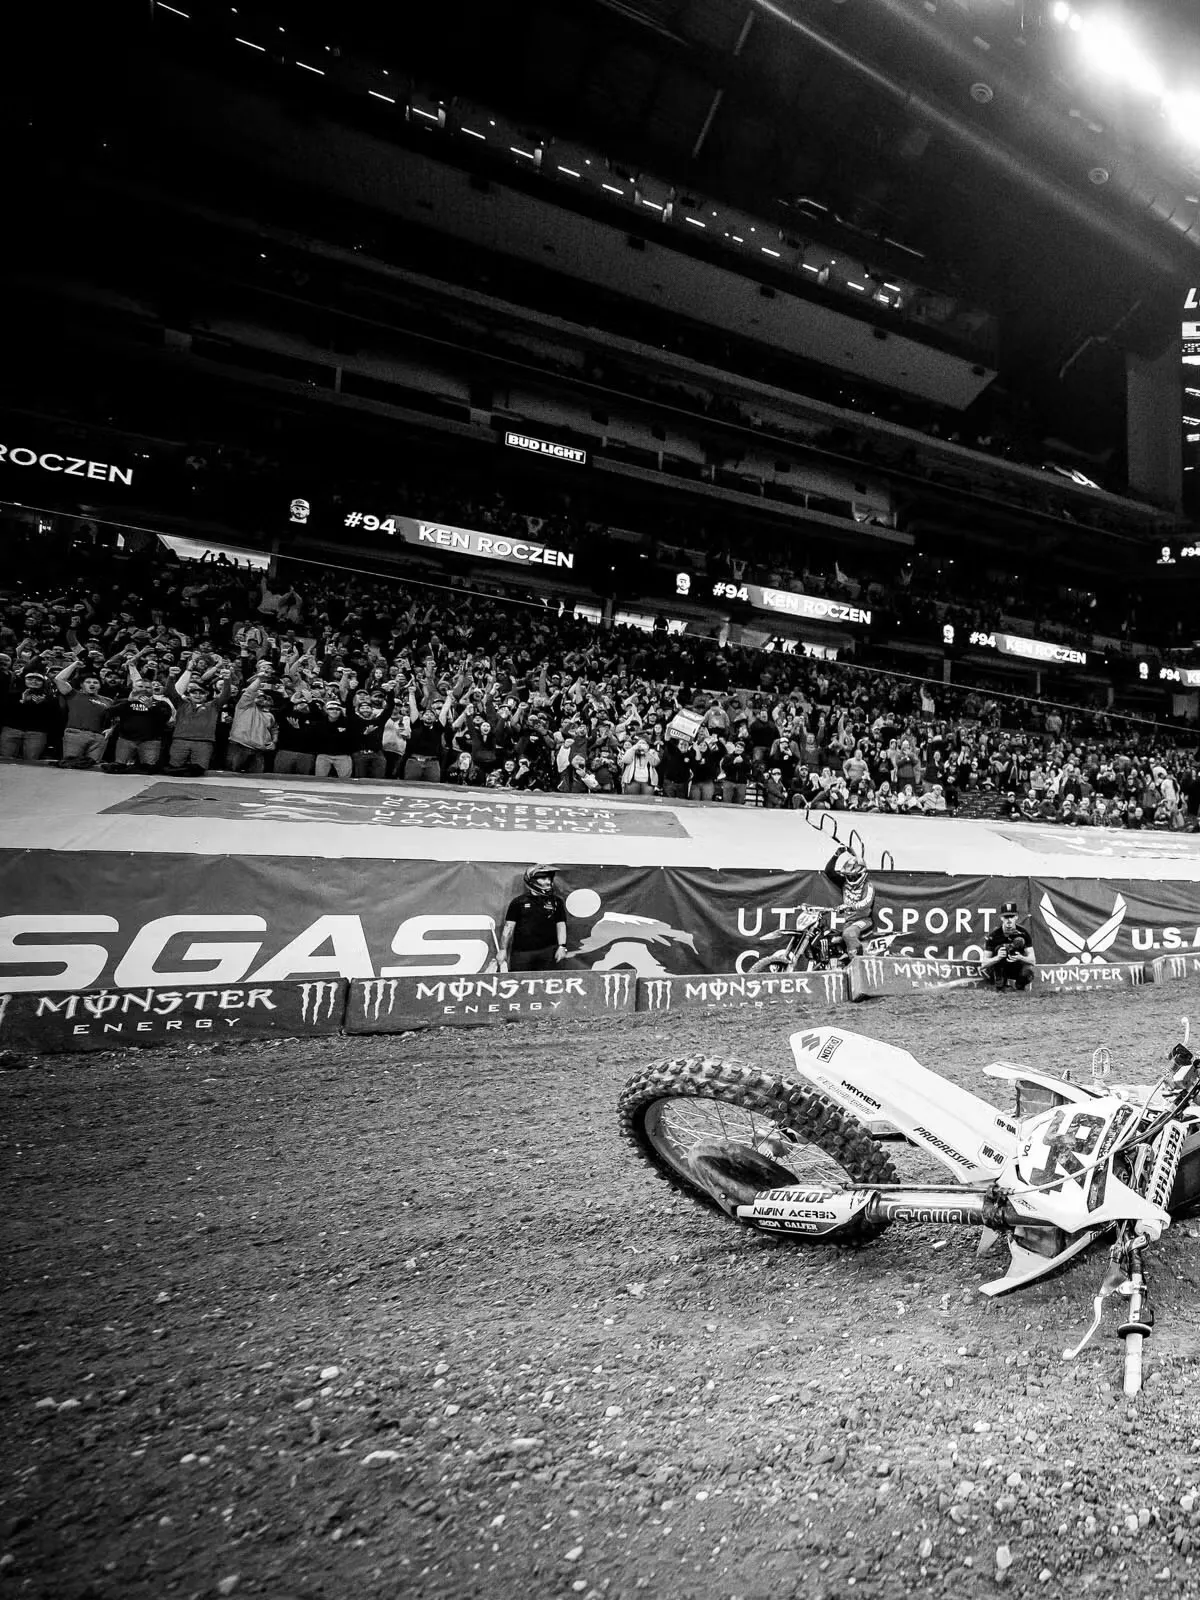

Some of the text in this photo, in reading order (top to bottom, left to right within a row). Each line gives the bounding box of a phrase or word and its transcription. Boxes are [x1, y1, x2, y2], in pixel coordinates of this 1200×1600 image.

[508, 434, 583, 461] BUD LIGHT
[0, 443, 133, 486] ROCZEN
[344, 511, 574, 569] #94 KEN ROCZEN
[1181, 547, 1200, 557] #94
[713, 582, 872, 625] #94 KEN ROCZEN
[969, 631, 1087, 665] #94 KEN ROCZEN
[1160, 667, 1180, 682] #94
[373, 816, 618, 833] COMMISSION
[375, 809, 472, 821] UTAH
[737, 907, 997, 937] UTH SPORT
[1131, 926, 1189, 950] U.S.
[0, 914, 497, 991] SGAS
[1040, 966, 1124, 984] MONSTER
[416, 975, 587, 1002] MONSTER
[685, 976, 813, 1001] MONSTER
[36, 987, 277, 1019] MONSTER
[444, 1001, 562, 1015] ENERGY
[73, 1018, 241, 1035] ENERGY
[841, 1079, 882, 1110] MAYHEM
[996, 1118, 1017, 1135] WD-40
[912, 1126, 978, 1171] PROGRESSIVE
[982, 1144, 1005, 1166] WD-40
[1152, 1125, 1181, 1208] RENTHA
[755, 1189, 833, 1204] DUNLOP
[753, 1206, 784, 1217] NISSIN
